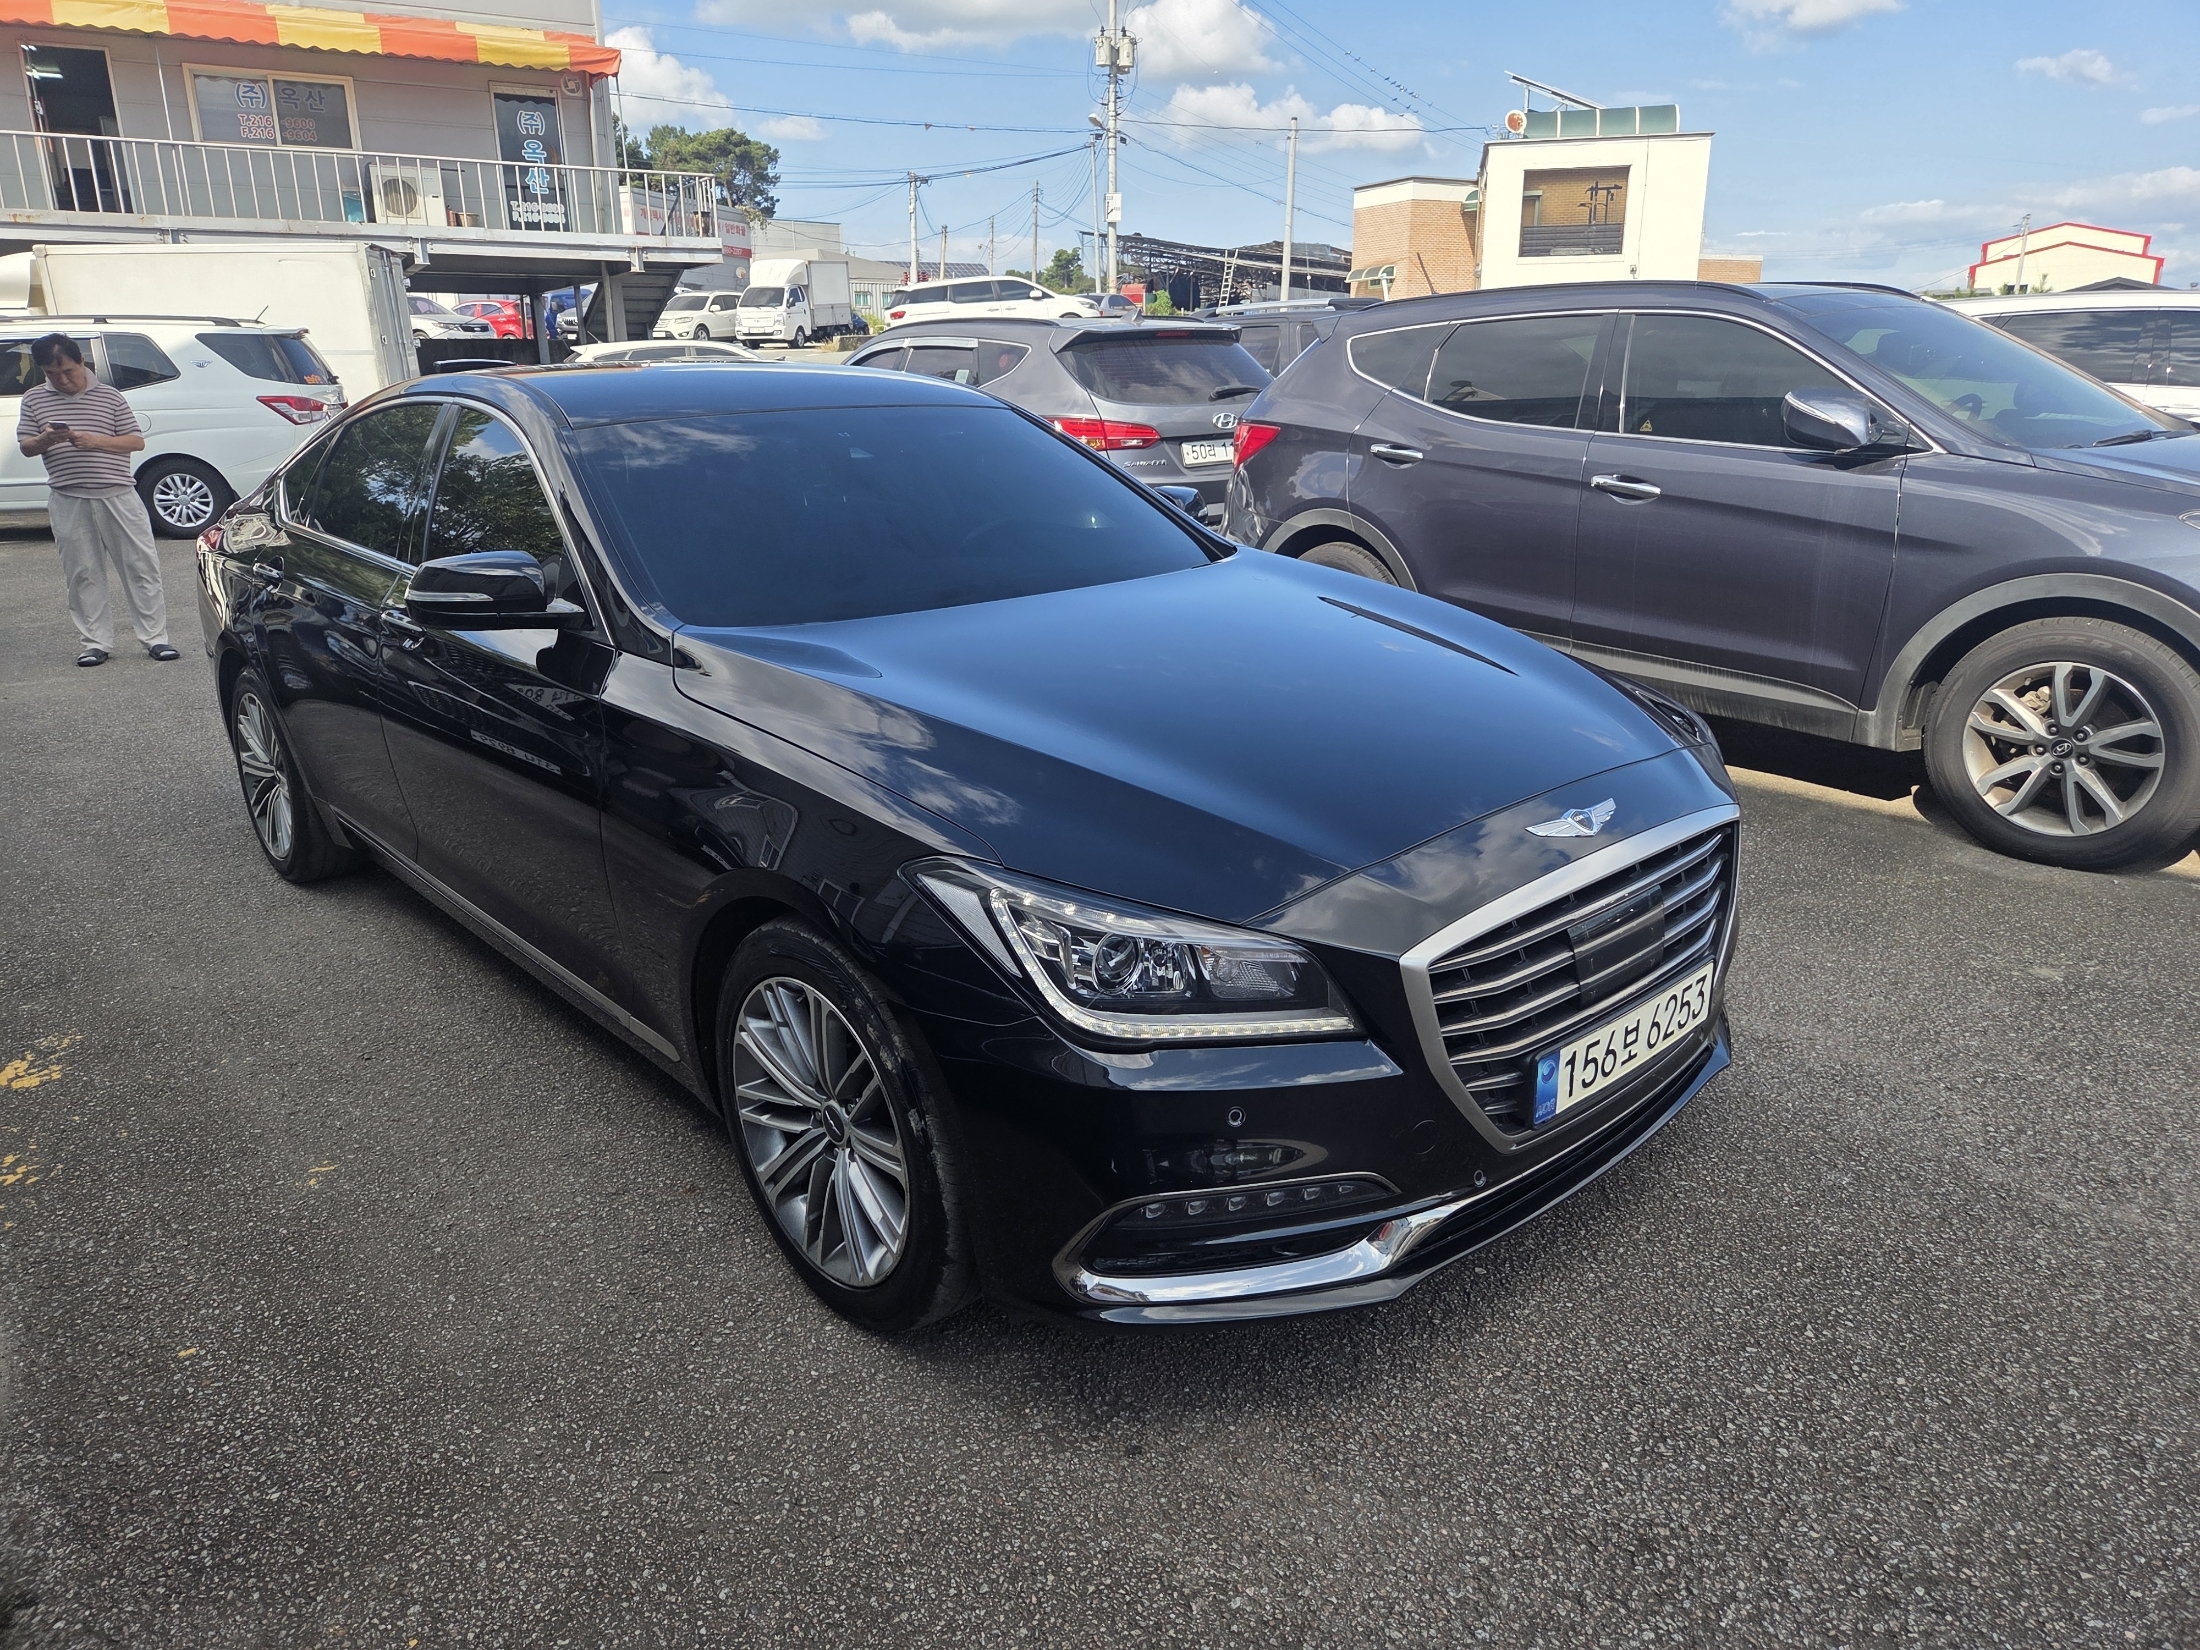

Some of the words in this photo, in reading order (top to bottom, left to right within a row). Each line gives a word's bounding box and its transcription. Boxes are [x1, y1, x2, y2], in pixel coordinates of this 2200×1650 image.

[235, 83, 267, 108] (주)
[278, 87, 326, 112] 옥산
[238, 114, 273, 127] T.216
[241, 127, 275, 139] F.216
[517, 110, 545, 135] (주)
[522, 140, 550, 194] 옥산
[1564, 1017, 1641, 1098] 156보
[1646, 973, 1708, 1050] 6253
